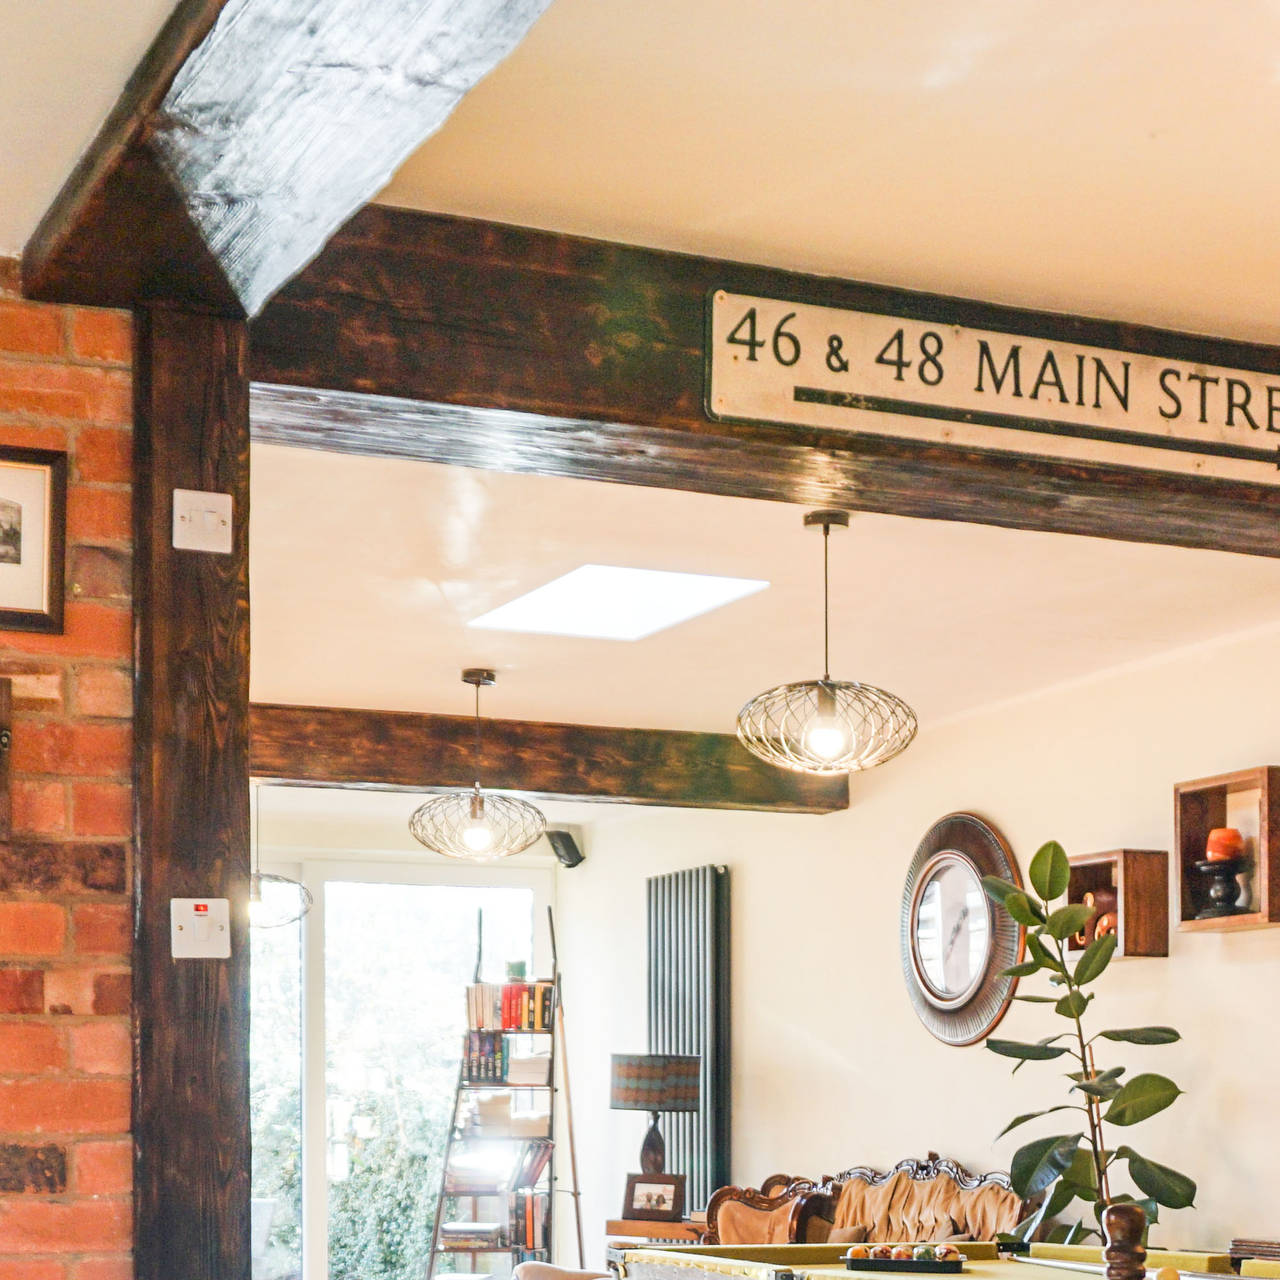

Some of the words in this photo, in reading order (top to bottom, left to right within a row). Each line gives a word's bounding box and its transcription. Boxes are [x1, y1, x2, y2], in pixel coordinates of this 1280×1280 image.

[725, 306, 803, 367] 46
[823, 333, 851, 374] &
[873, 327, 946, 387] 48
[973, 338, 1132, 413] MAIN
